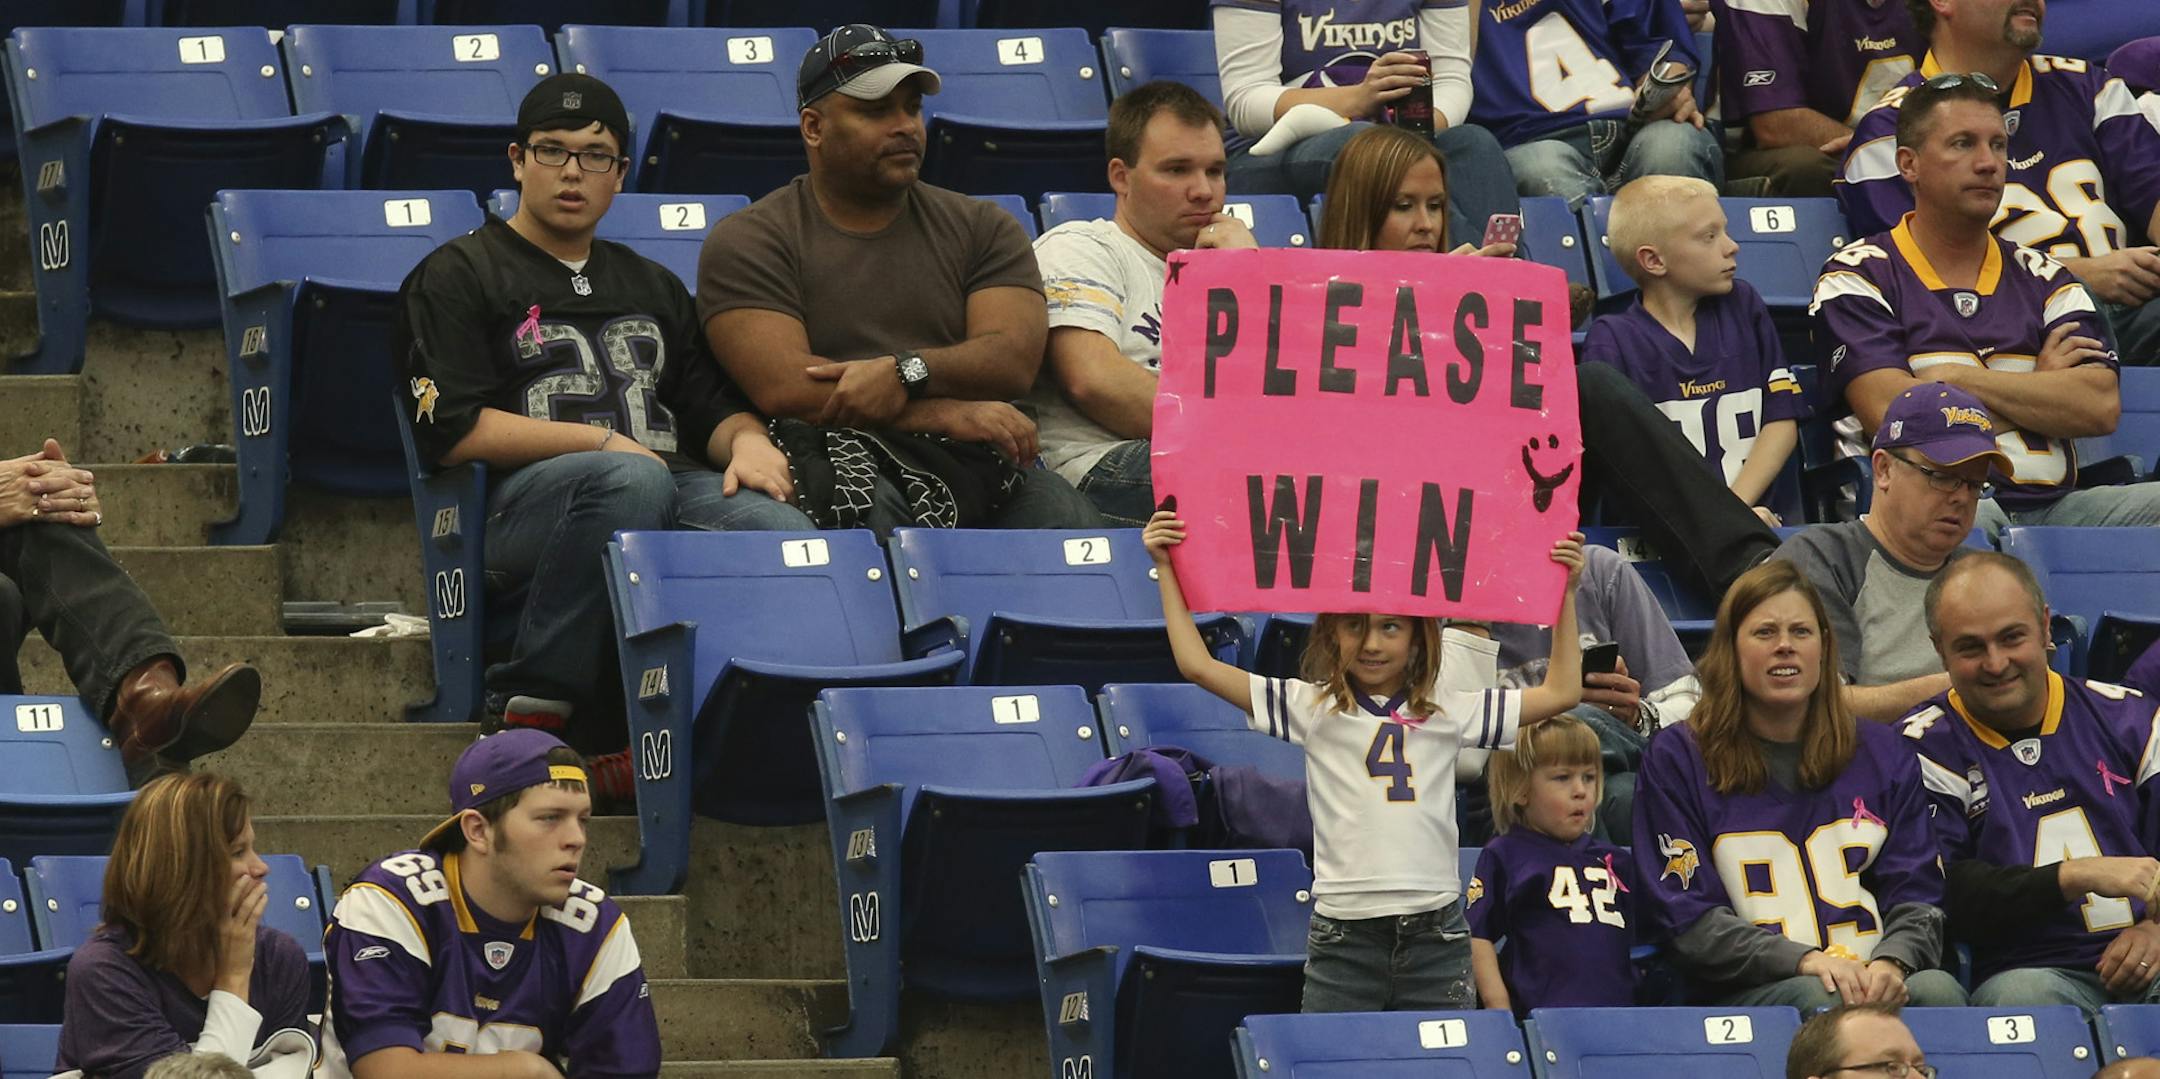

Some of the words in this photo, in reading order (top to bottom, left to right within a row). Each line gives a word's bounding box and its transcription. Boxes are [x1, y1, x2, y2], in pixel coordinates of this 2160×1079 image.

[197, 40, 206, 60] 1
[470, 38, 483, 58] 2
[744, 40, 757, 60] 3
[1014, 40, 1028, 60] 4
[1525, 11, 1636, 114] 4
[403, 203, 413, 224] 1
[675, 206, 689, 227] 2
[1766, 209, 1780, 231] 6
[246, 328, 261, 353] 16
[1203, 280, 1544, 410] PLEASE
[516, 318, 678, 453] 28
[437, 509, 452, 535] 15
[1246, 475, 1475, 603] WIN
[801, 543, 811, 564] 1
[1080, 541, 1094, 562] 2
[643, 670, 660, 696] 14
[29, 706, 52, 728] 11
[1011, 698, 1021, 720] 1
[1365, 722, 1417, 803] 4
[851, 832, 867, 857] 13
[1228, 862, 1240, 885] 1
[1547, 865, 1626, 929] 42
[1064, 995, 1079, 1021] 12
[1439, 1023, 1450, 1045] 1
[1722, 1019, 1736, 1042] 2
[2005, 1019, 2019, 1042] 3
